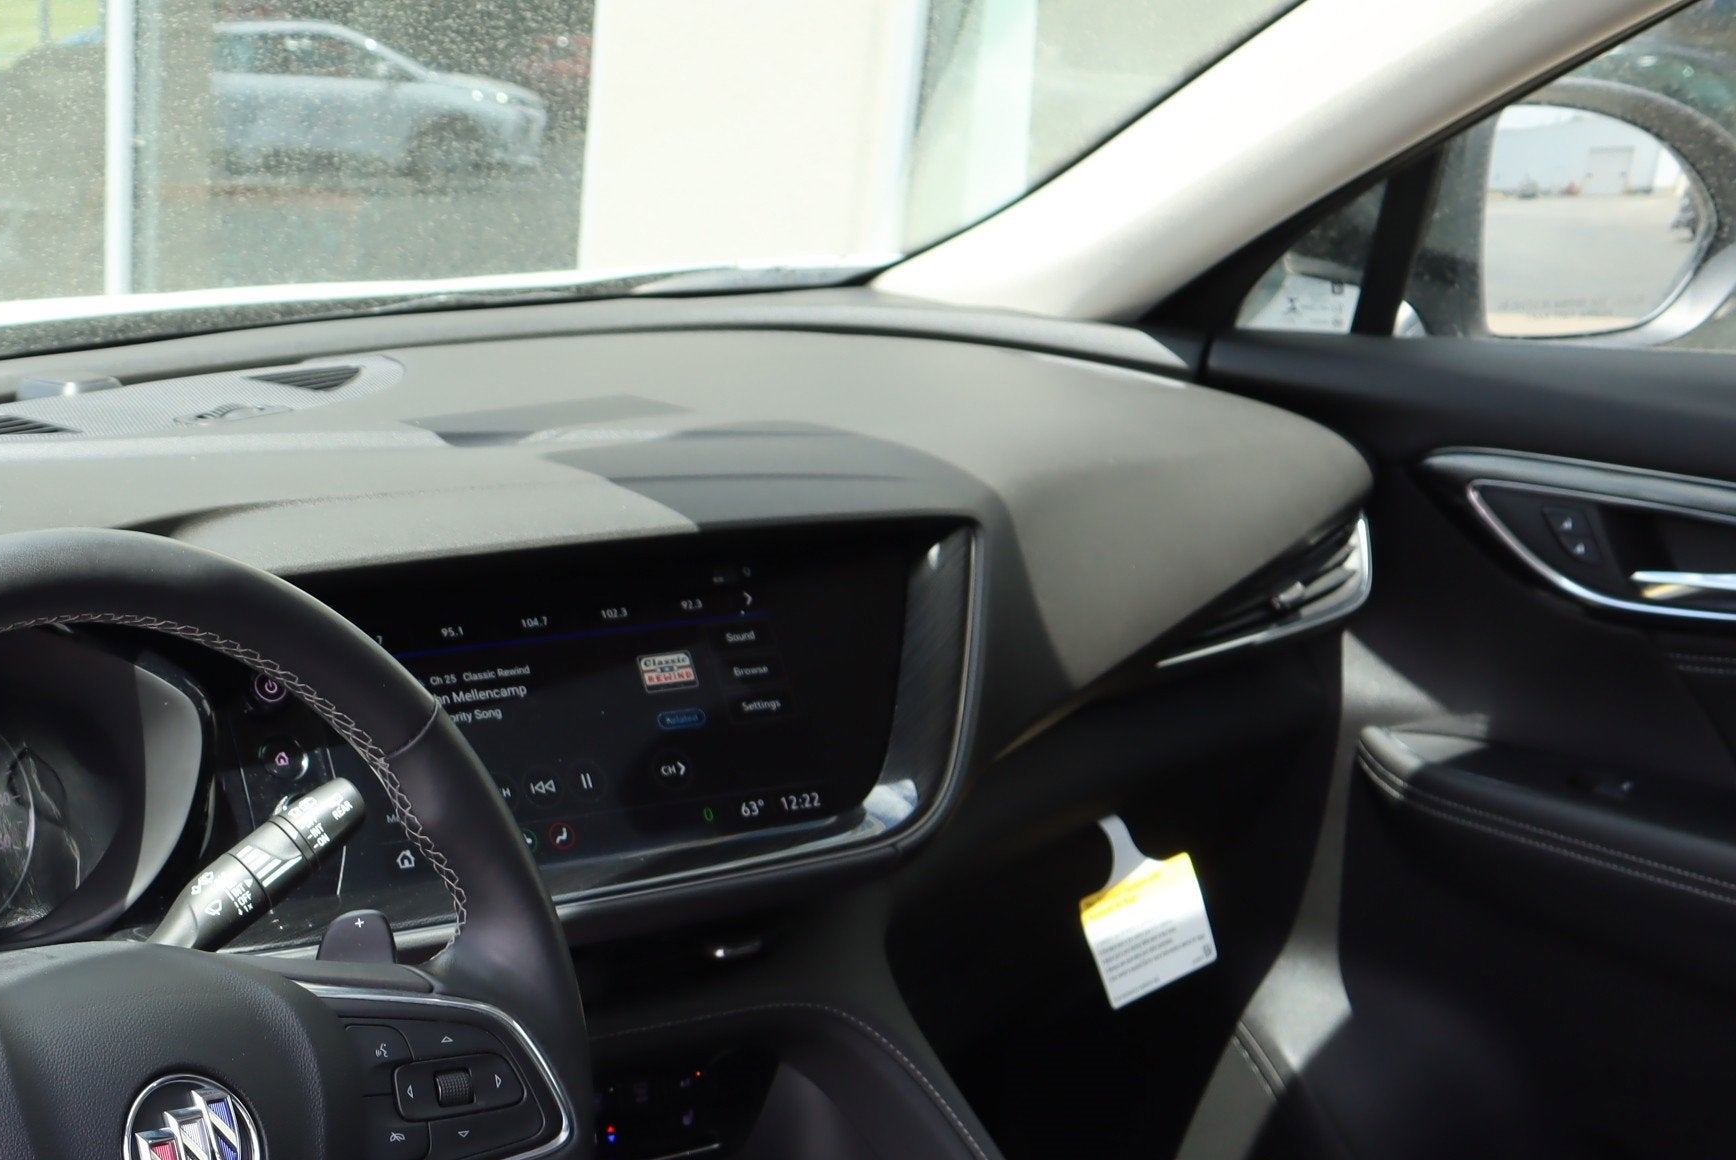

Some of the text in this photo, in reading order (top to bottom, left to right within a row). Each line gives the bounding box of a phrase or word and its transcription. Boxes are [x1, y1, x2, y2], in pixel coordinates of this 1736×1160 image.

[521, 616, 548, 629] 104.7
[441, 626, 464, 638] 95.1
[725, 629, 756, 643] Sound
[430, 664, 531, 686] Ch 25 Classic Rewind
[733, 664, 769, 678] Browse
[452, 685, 527, 703] Mellencamp
[742, 699, 783, 713] Settings
[474, 707, 503, 721] Song
[780, 791, 821, 812] 12:22
